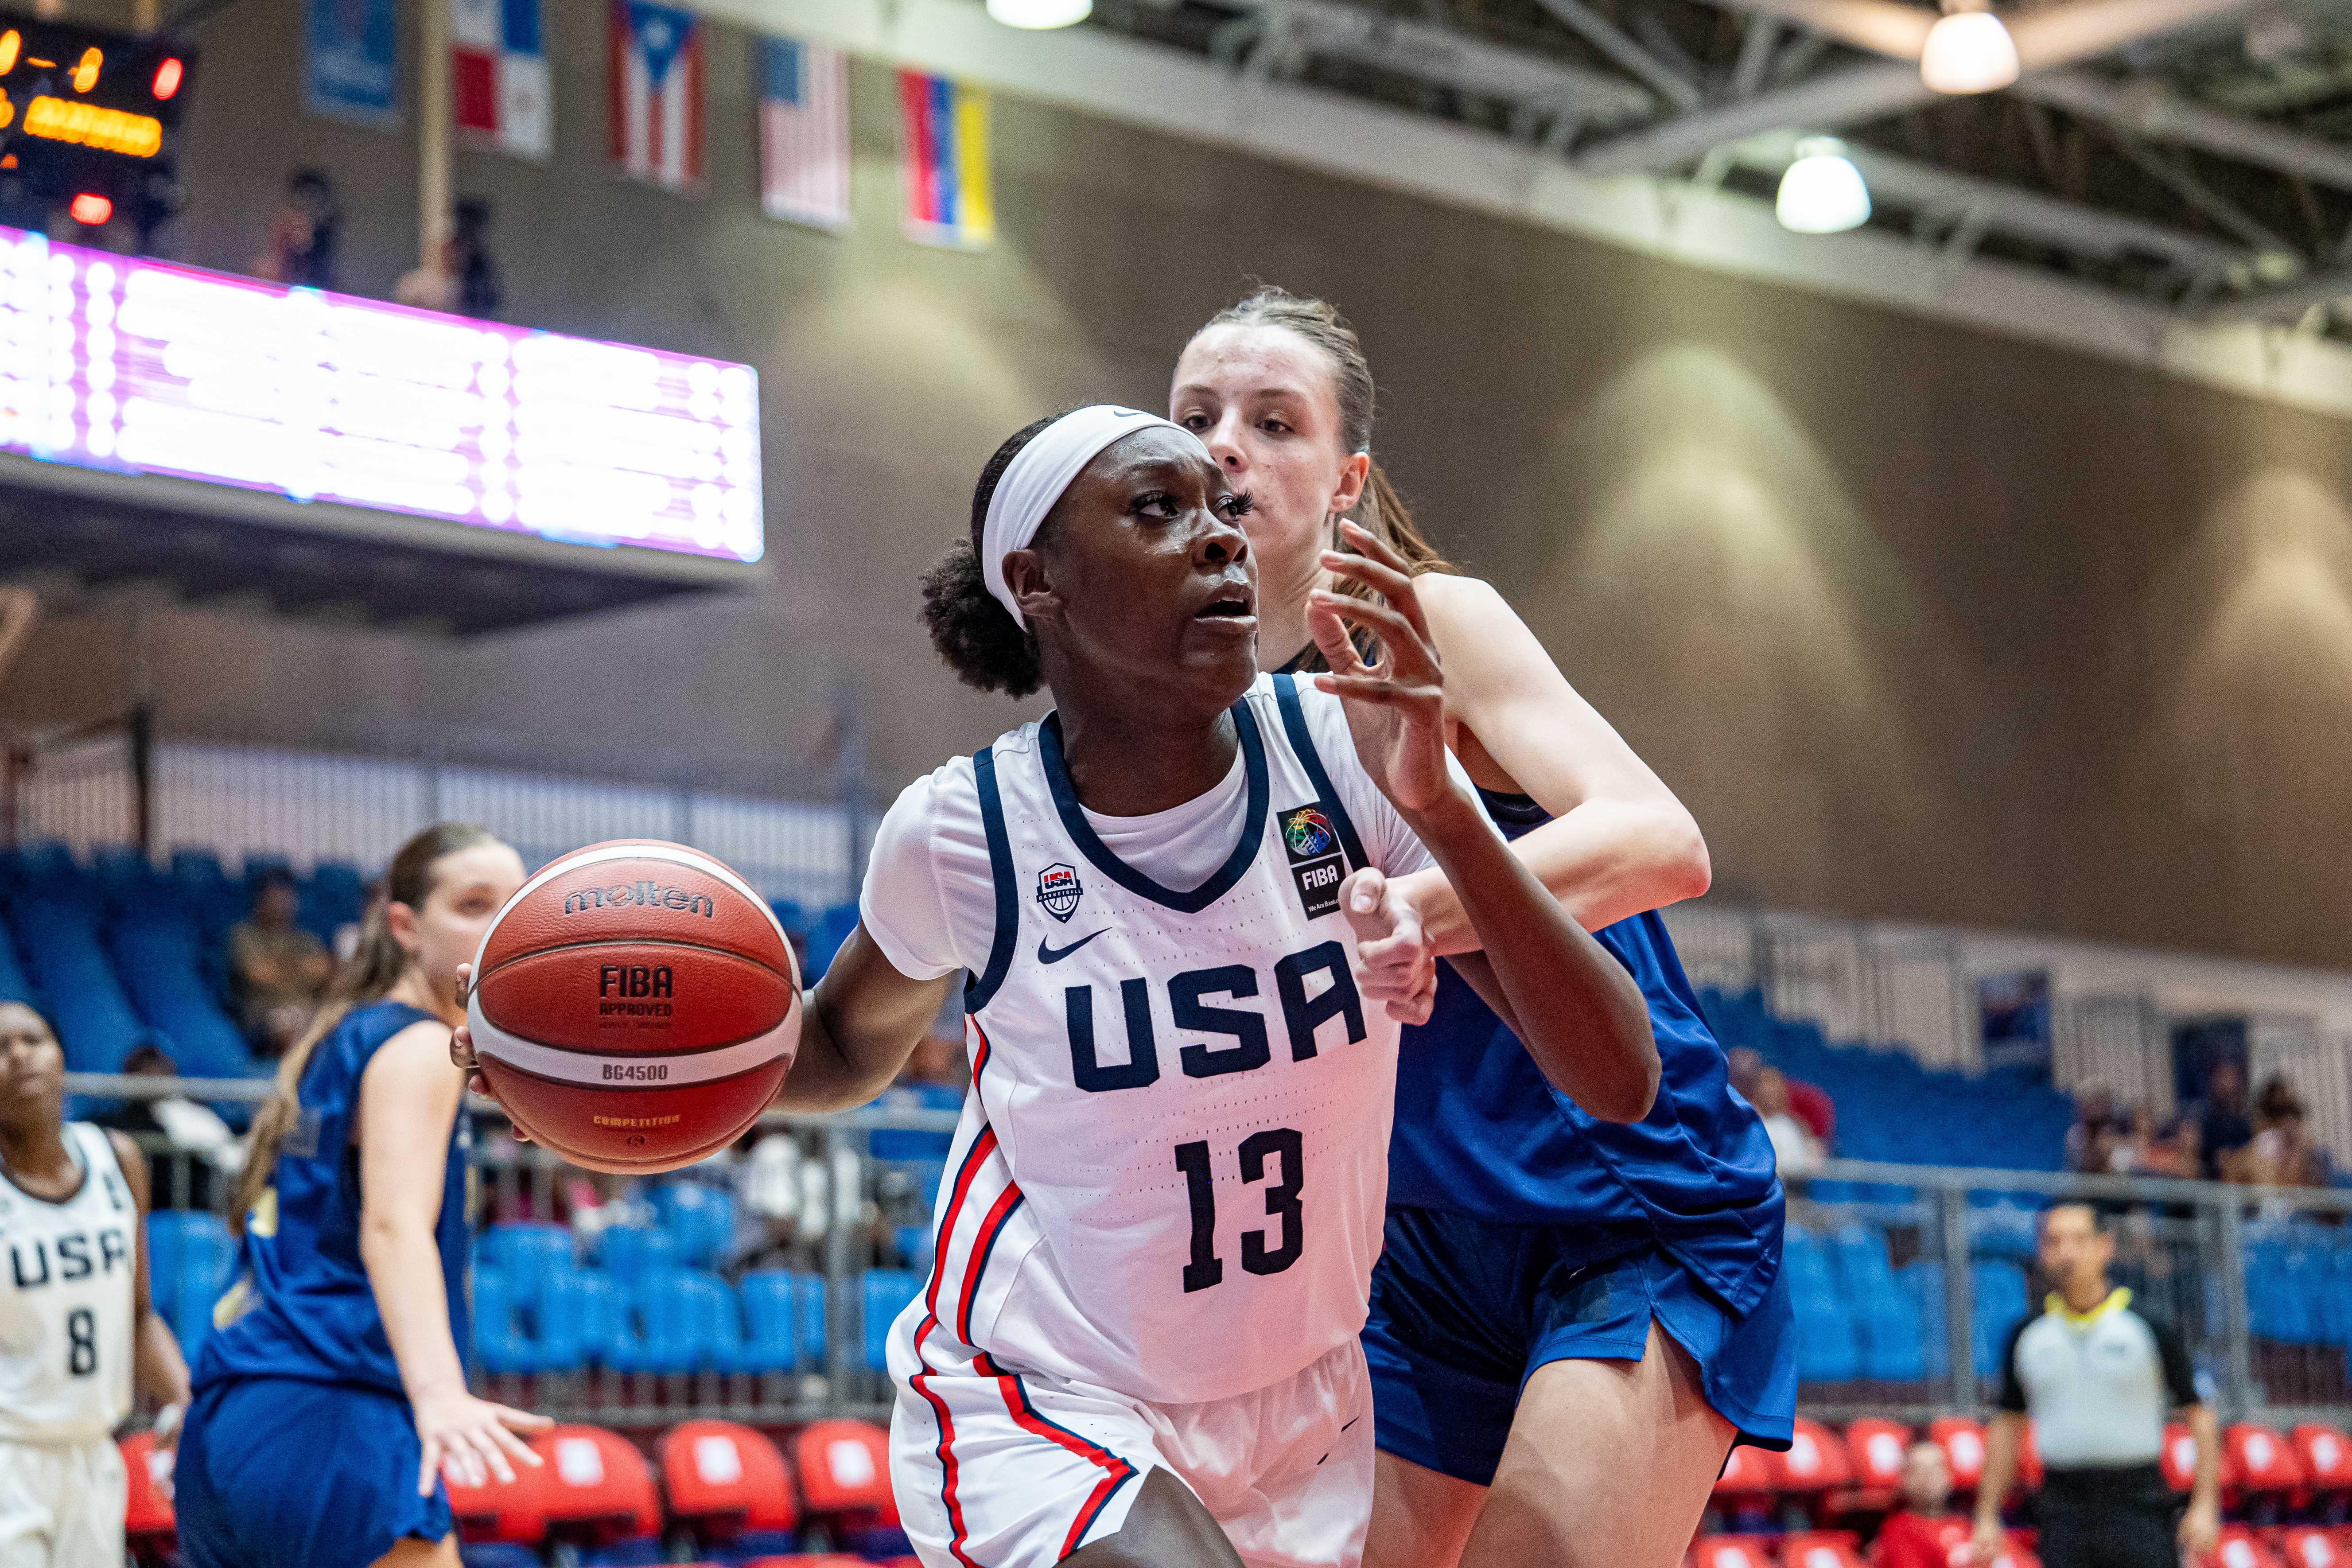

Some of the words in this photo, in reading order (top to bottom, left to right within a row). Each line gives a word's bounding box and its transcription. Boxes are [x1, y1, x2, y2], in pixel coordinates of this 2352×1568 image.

[1044, 871, 1074, 890] USA
[1302, 864, 1339, 890] FIBA
[565, 881, 713, 918] molten
[1038, 889, 1081, 900] BASKETBALL
[1325, 899, 1339, 907] Baske
[599, 965, 673, 998] FIBA
[599, 1003, 673, 1016] APPROVED
[1065, 940, 1368, 1093] USA
[603, 1064, 668, 1081] BG4500
[593, 1114, 680, 1127] COMPETITION
[1174, 1128, 1304, 1293] 13
[11, 1227, 127, 1291] USA
[68, 1304, 97, 1378] 8
